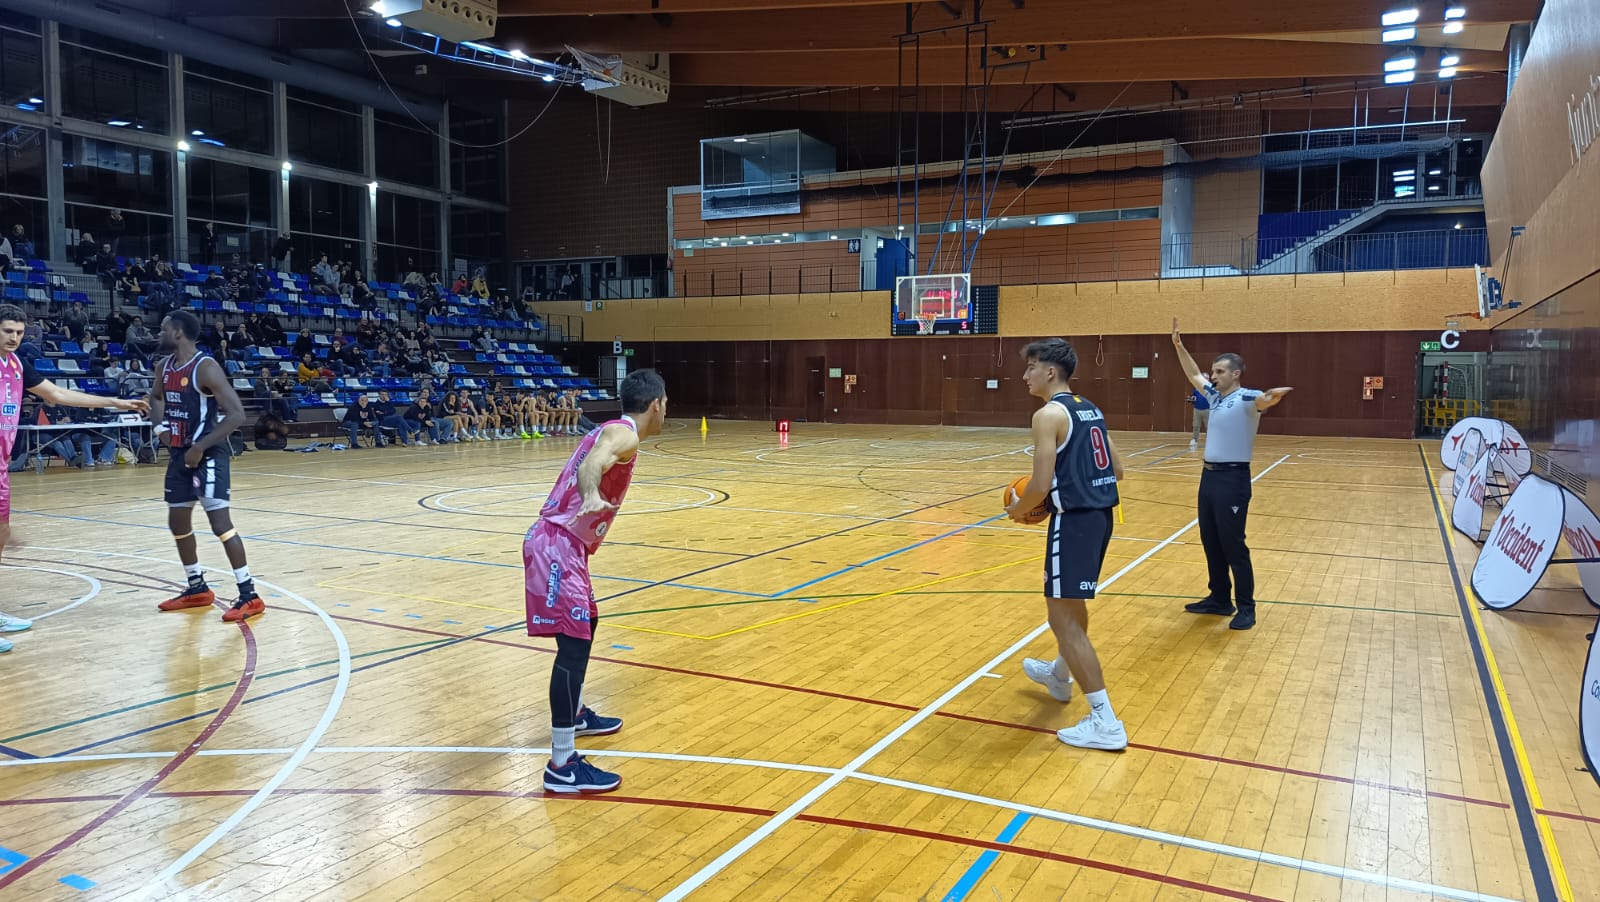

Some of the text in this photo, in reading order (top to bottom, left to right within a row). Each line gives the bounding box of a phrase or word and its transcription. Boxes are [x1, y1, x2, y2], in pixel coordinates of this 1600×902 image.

[613, 341, 623, 354] B
[1440, 329, 1460, 349] C
[1090, 426, 1110, 470] 9
[1496, 515, 1545, 574] Occident
